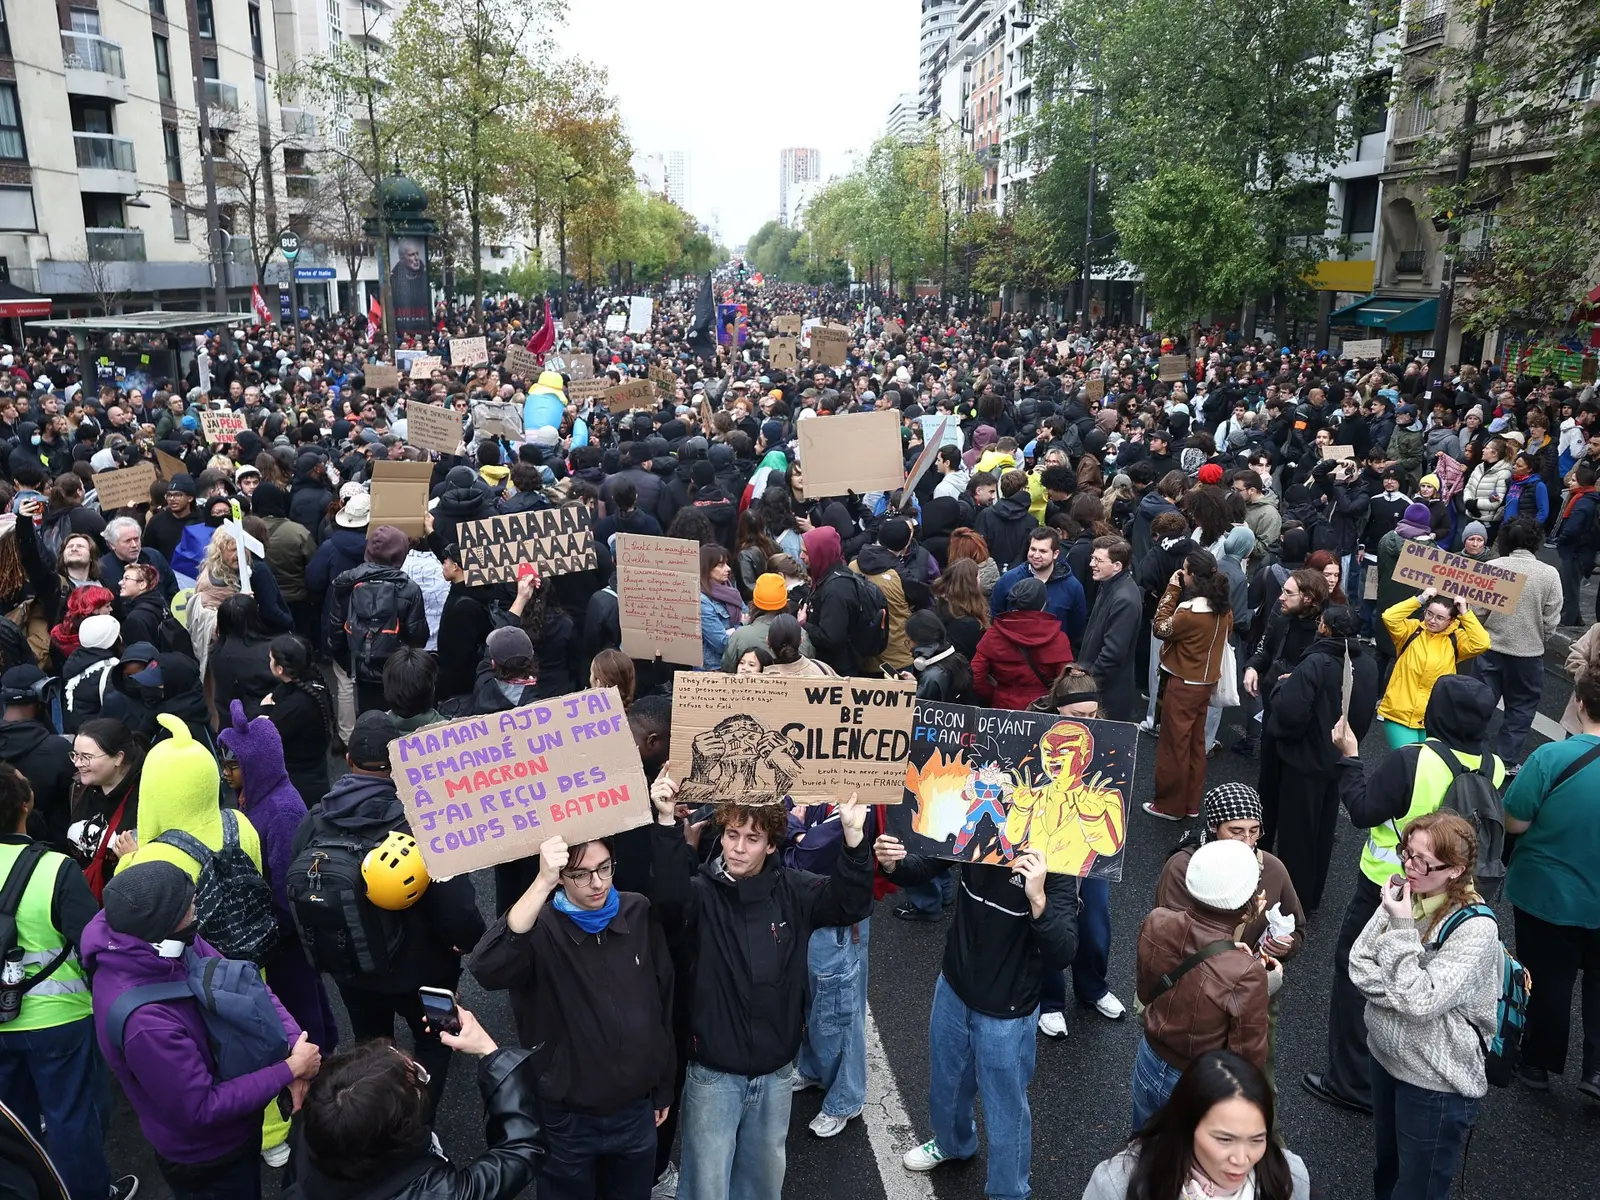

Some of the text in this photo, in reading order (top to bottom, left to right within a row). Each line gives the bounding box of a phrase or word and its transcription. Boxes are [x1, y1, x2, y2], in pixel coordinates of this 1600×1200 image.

[281, 238, 297, 247] BUS
[609, 385, 650, 406] ARNAQUE
[220, 419, 243, 429] PEUR
[623, 537, 698, 556] Liberté de manifester
[622, 552, 650, 563] Quelles
[655, 560, 664, 568] que
[1443, 553, 1469, 569] PAS
[1473, 561, 1517, 582] ENCORE
[647, 578, 670, 588] citoyen
[1400, 567, 1435, 586] CETTE
[1442, 580, 1508, 607] PANCARTE
[1431, 564, 1498, 591] CONFISQUÉ
[649, 587, 677, 595] exprimer
[680, 677, 700, 686] They
[722, 676, 756, 684] TRUTH
[805, 687, 916, 708] WE WON'T
[840, 706, 863, 725] BE
[398, 721, 489, 763] MAMAN
[499, 706, 552, 733] AJD
[914, 726, 977, 747] FRANCE
[978, 717, 1036, 737] DEVANT
[405, 714, 622, 786] DEMANDÉ UN PROF
[781, 722, 910, 761] SILENCED
[414, 756, 549, 808] À MACRON
[801, 778, 827, 786] buried
[843, 778, 861, 789] long
[420, 766, 607, 832] J'AI REÇU DES
[429, 784, 630, 854] COUPS DE BATON
